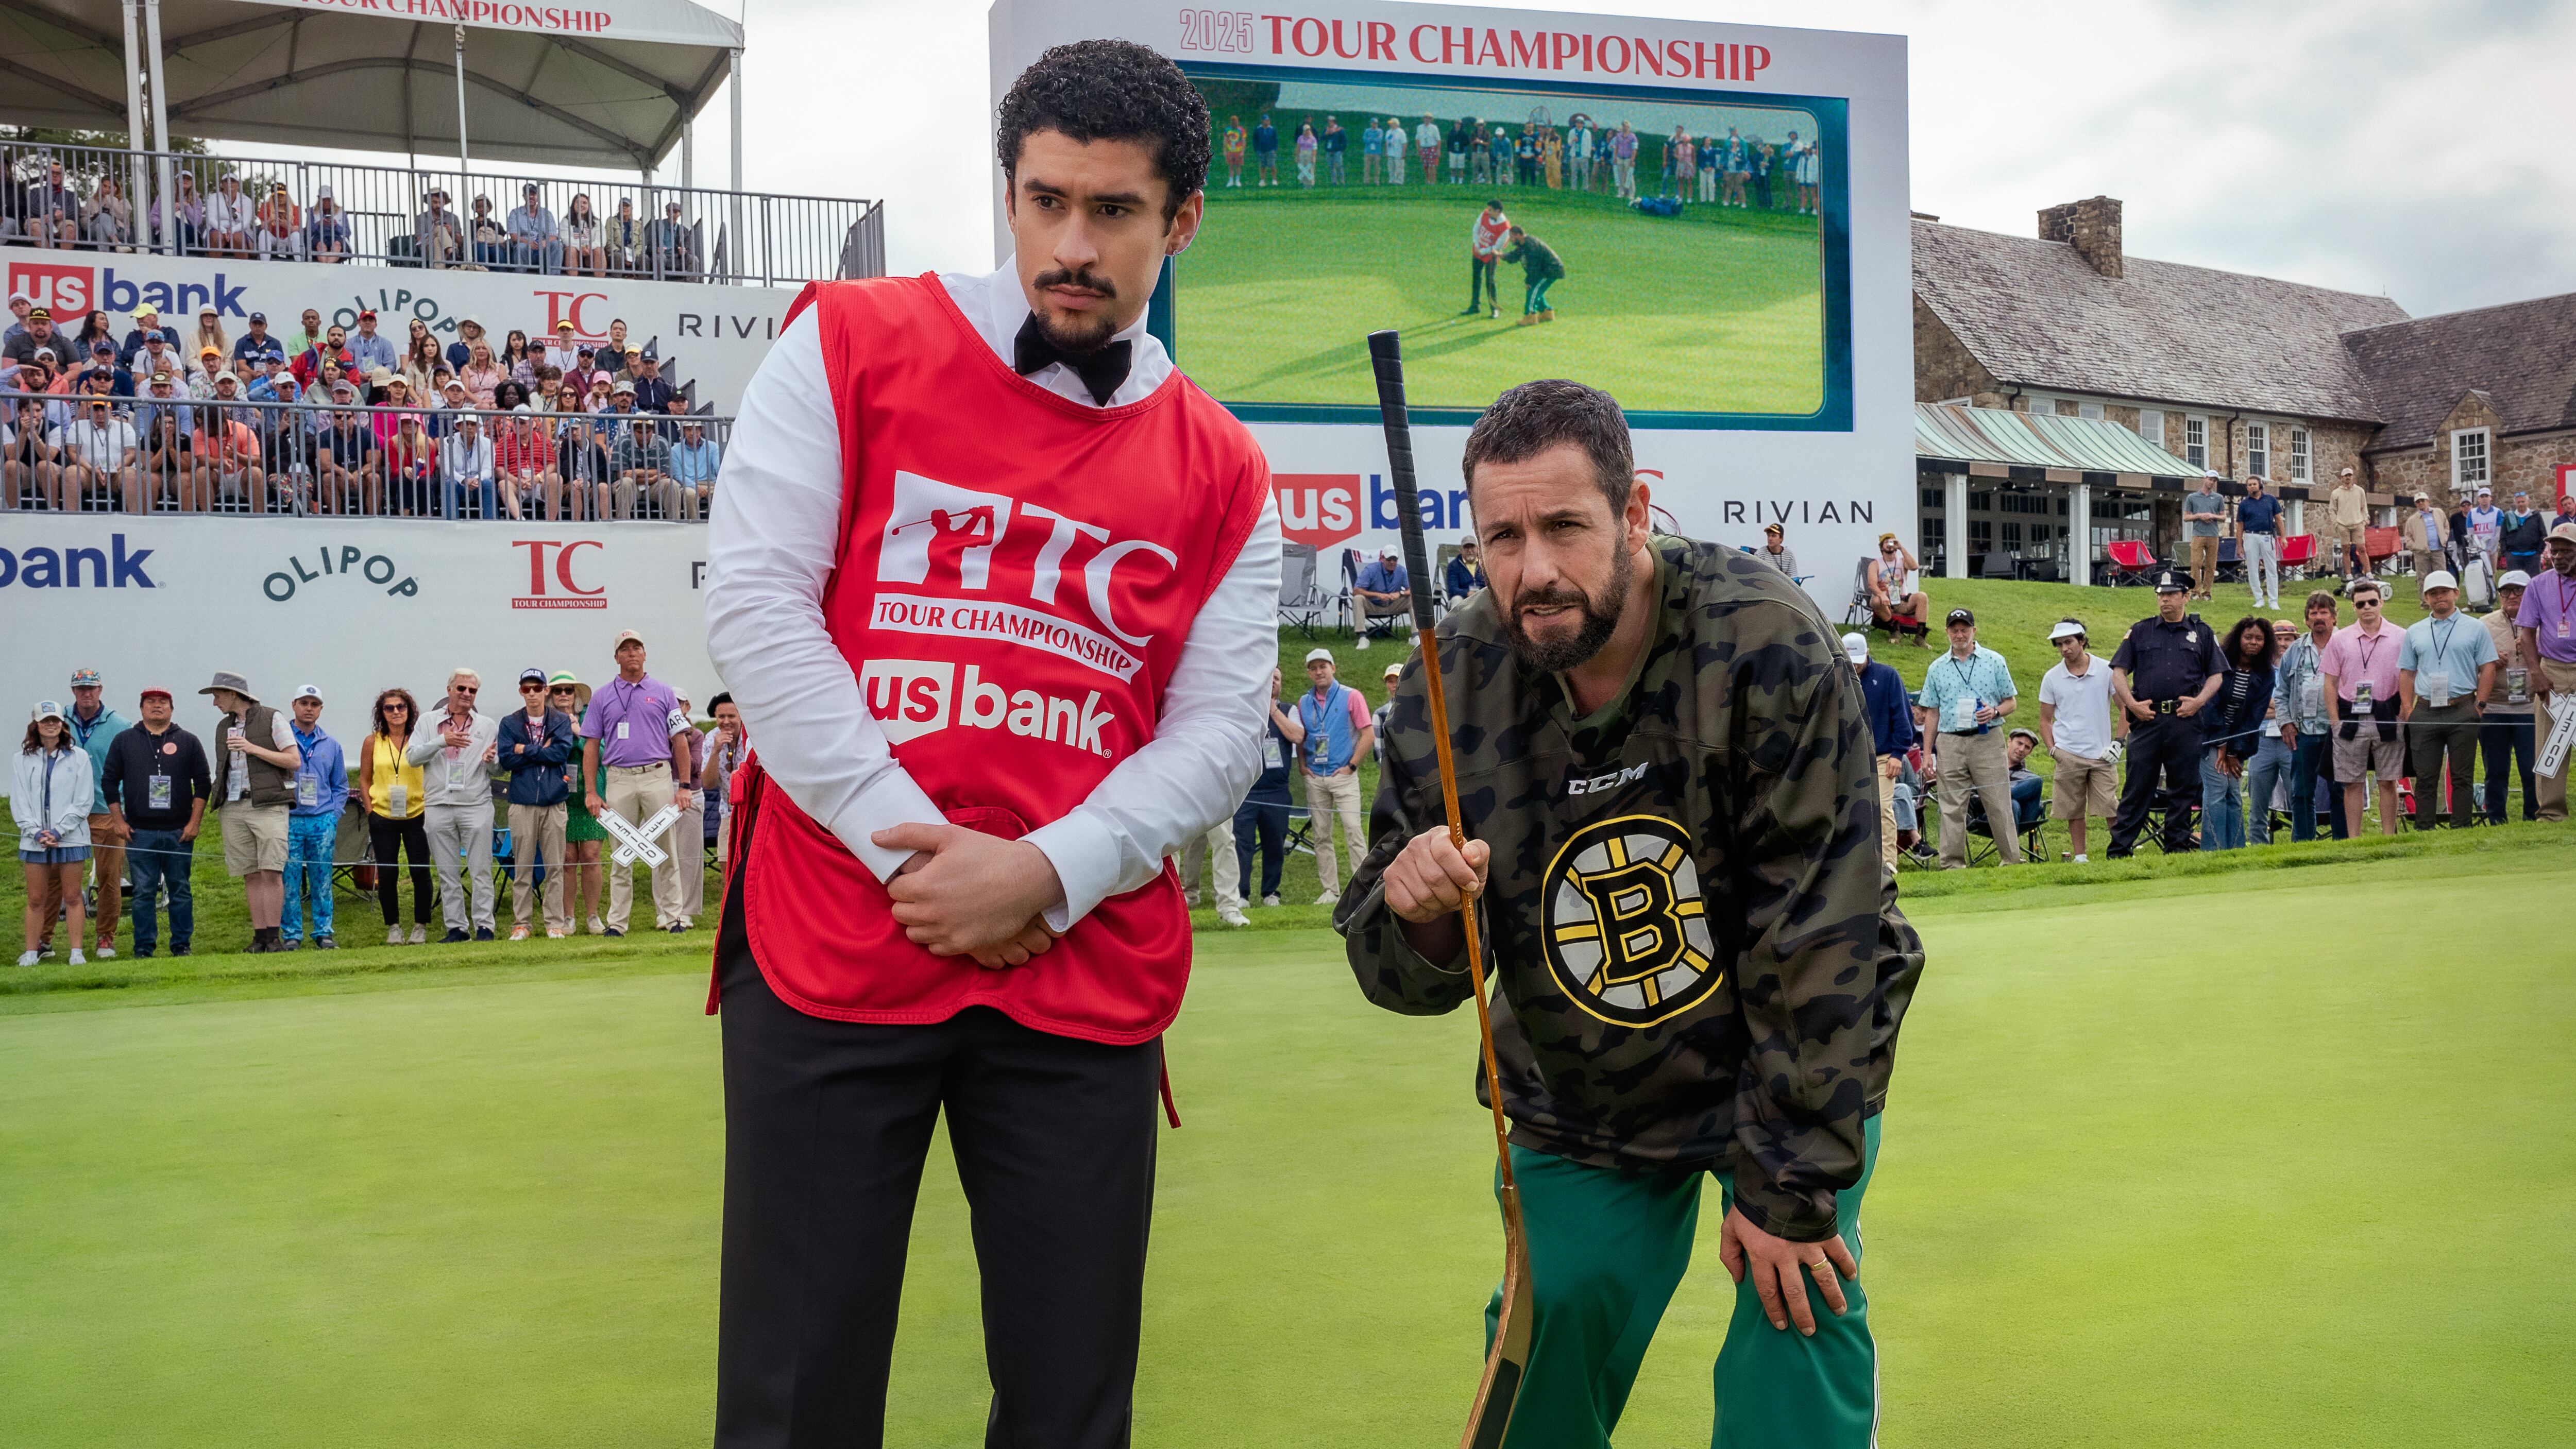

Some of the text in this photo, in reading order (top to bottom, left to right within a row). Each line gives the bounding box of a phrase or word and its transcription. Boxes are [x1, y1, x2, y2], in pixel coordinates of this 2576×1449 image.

[386, 0, 612, 32] CHAMPIONSHIP
[1179, 9, 1771, 81] 2025 TOUR CHAMPIONSHIP
[104, 267, 248, 317] bank
[333, 288, 457, 332] OLIPOP
[534, 291, 608, 337] TC
[679, 313, 773, 340] RIVI
[1280, 474, 1470, 531] us ban
[1724, 501, 1873, 524] RIVIAN
[263, 545, 418, 602] OLIPOP
[512, 540, 605, 595] TC
[1020, 502, 1178, 647] TC
[878, 601, 1132, 673] TOUR CHAMPIONSHIP
[867, 676, 940, 722] us
[959, 664, 1115, 756] bank
[2544, 710, 2574, 768] QUIET
[1568, 761, 1649, 795] CCM
[614, 822, 657, 859] QUIET
[622, 817, 666, 857] QIET
[1581, 861, 1686, 984] B
